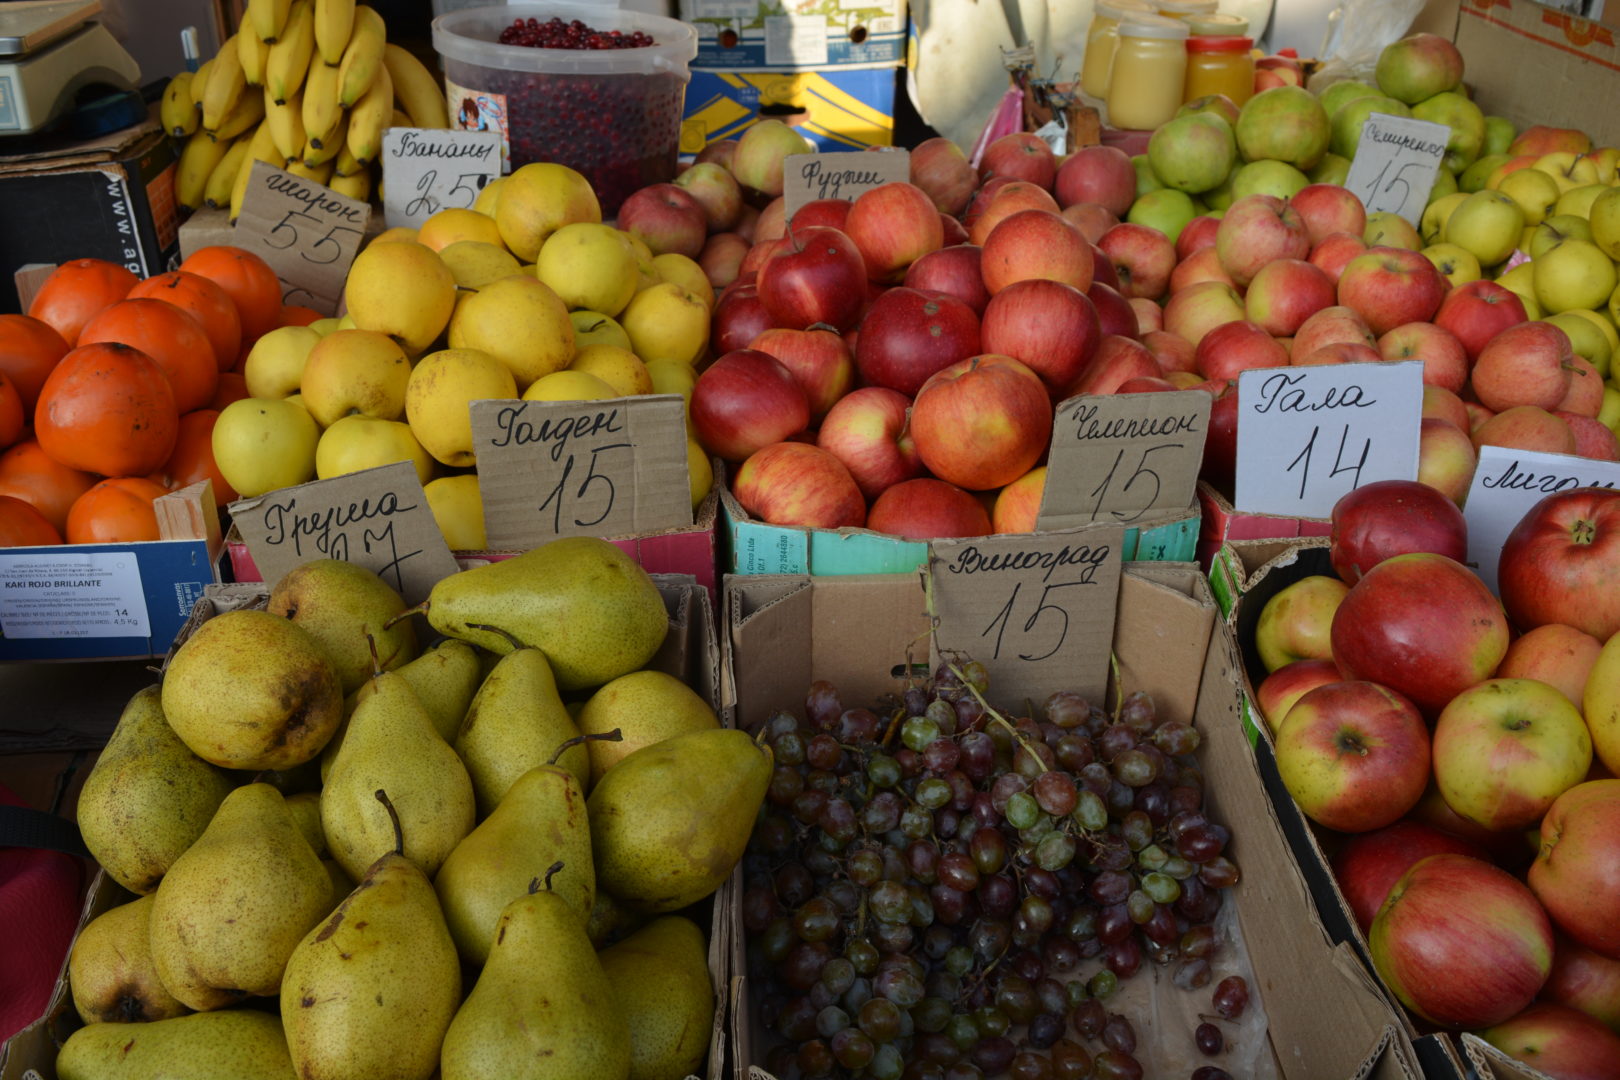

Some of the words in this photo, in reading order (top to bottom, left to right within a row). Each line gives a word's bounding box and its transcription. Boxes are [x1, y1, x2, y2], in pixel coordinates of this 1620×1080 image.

[392, 132, 495, 162] Бананы
[266, 174, 362, 223] Шарон
[405, 169, 495, 217] 25
[1366, 160, 1432, 214] 15
[263, 211, 364, 265] 55
[1254, 373, 1377, 413] Гала
[492, 403, 623, 461] Голден
[1072, 405, 1199, 440] Чемпион
[1091, 444, 1184, 522] 15
[1286, 424, 1371, 500] 14
[539, 443, 638, 534] 15
[264, 492, 418, 557] Груша
[5, 581, 26, 589] KAKI
[28, 581, 52, 589] ROJO
[54, 579, 102, 588] BRILLANTE
[949, 545, 1110, 584] Виноград
[114, 609, 129, 617] 14
[982, 582, 1098, 661] 15
